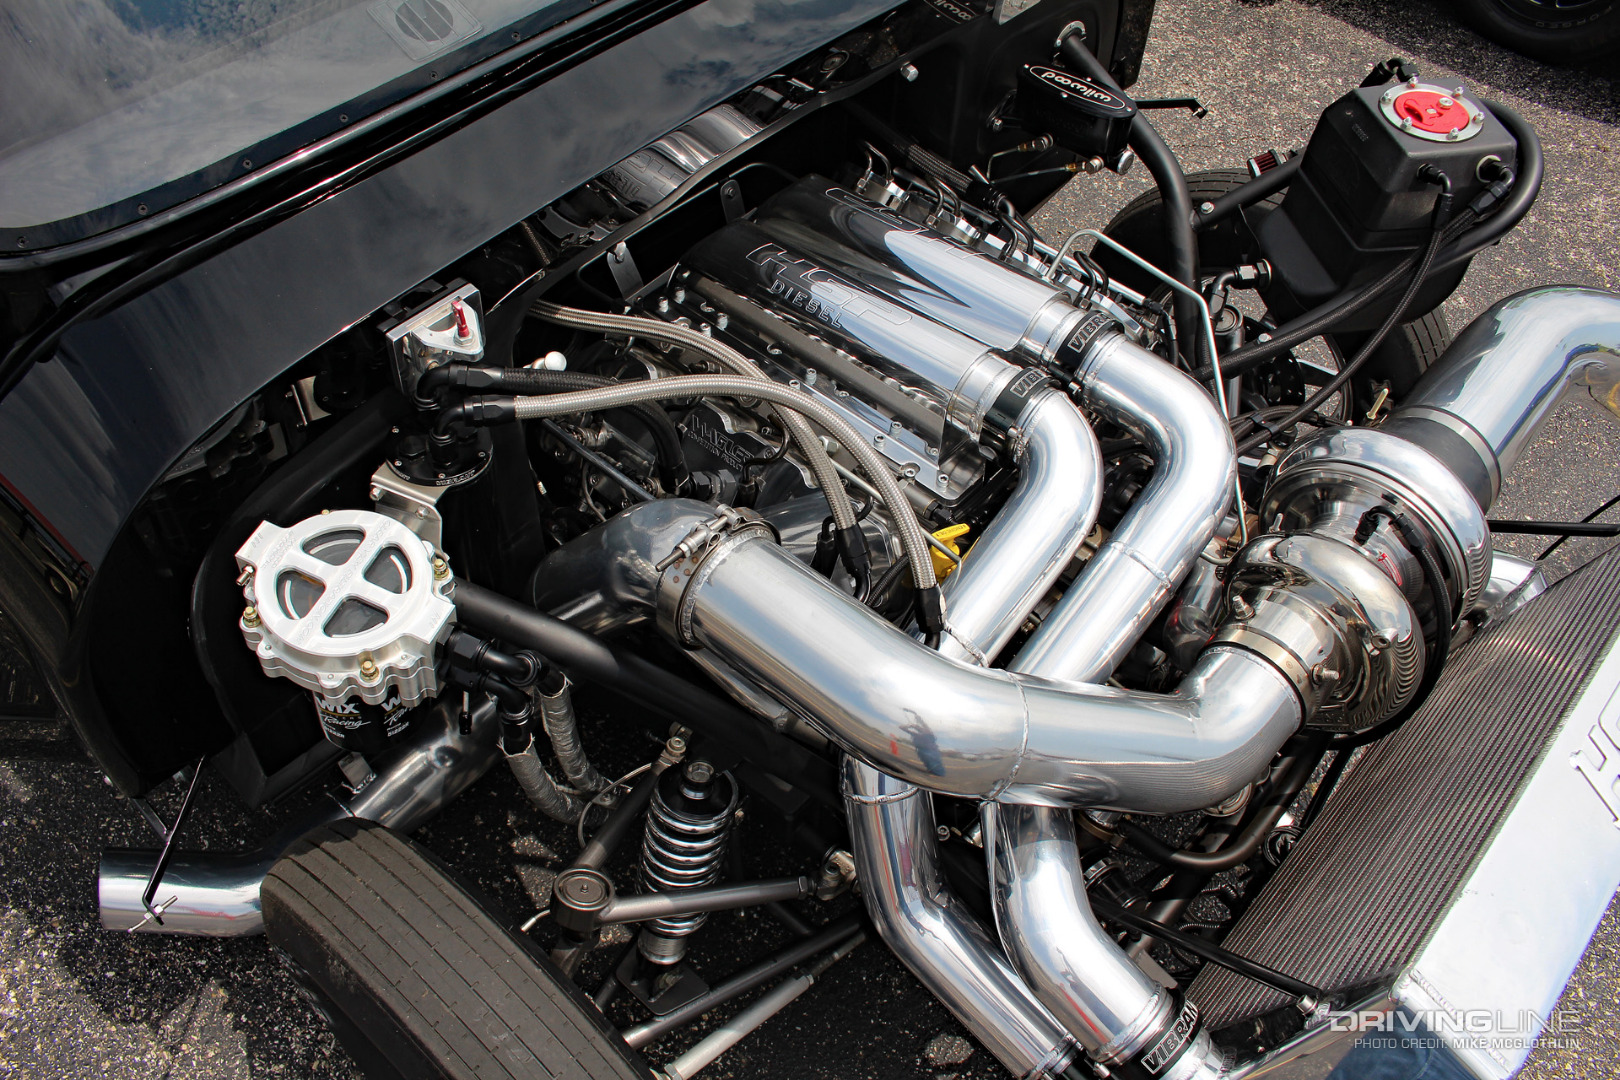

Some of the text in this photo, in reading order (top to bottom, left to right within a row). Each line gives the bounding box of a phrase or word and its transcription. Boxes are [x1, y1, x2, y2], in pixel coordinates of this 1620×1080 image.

[1041, 71, 1112, 102] wilwood
[746, 242, 912, 326] HSP
[770, 279, 842, 328] DIESEL
[315, 696, 360, 714] WIX
[320, 713, 372, 730] Racing
